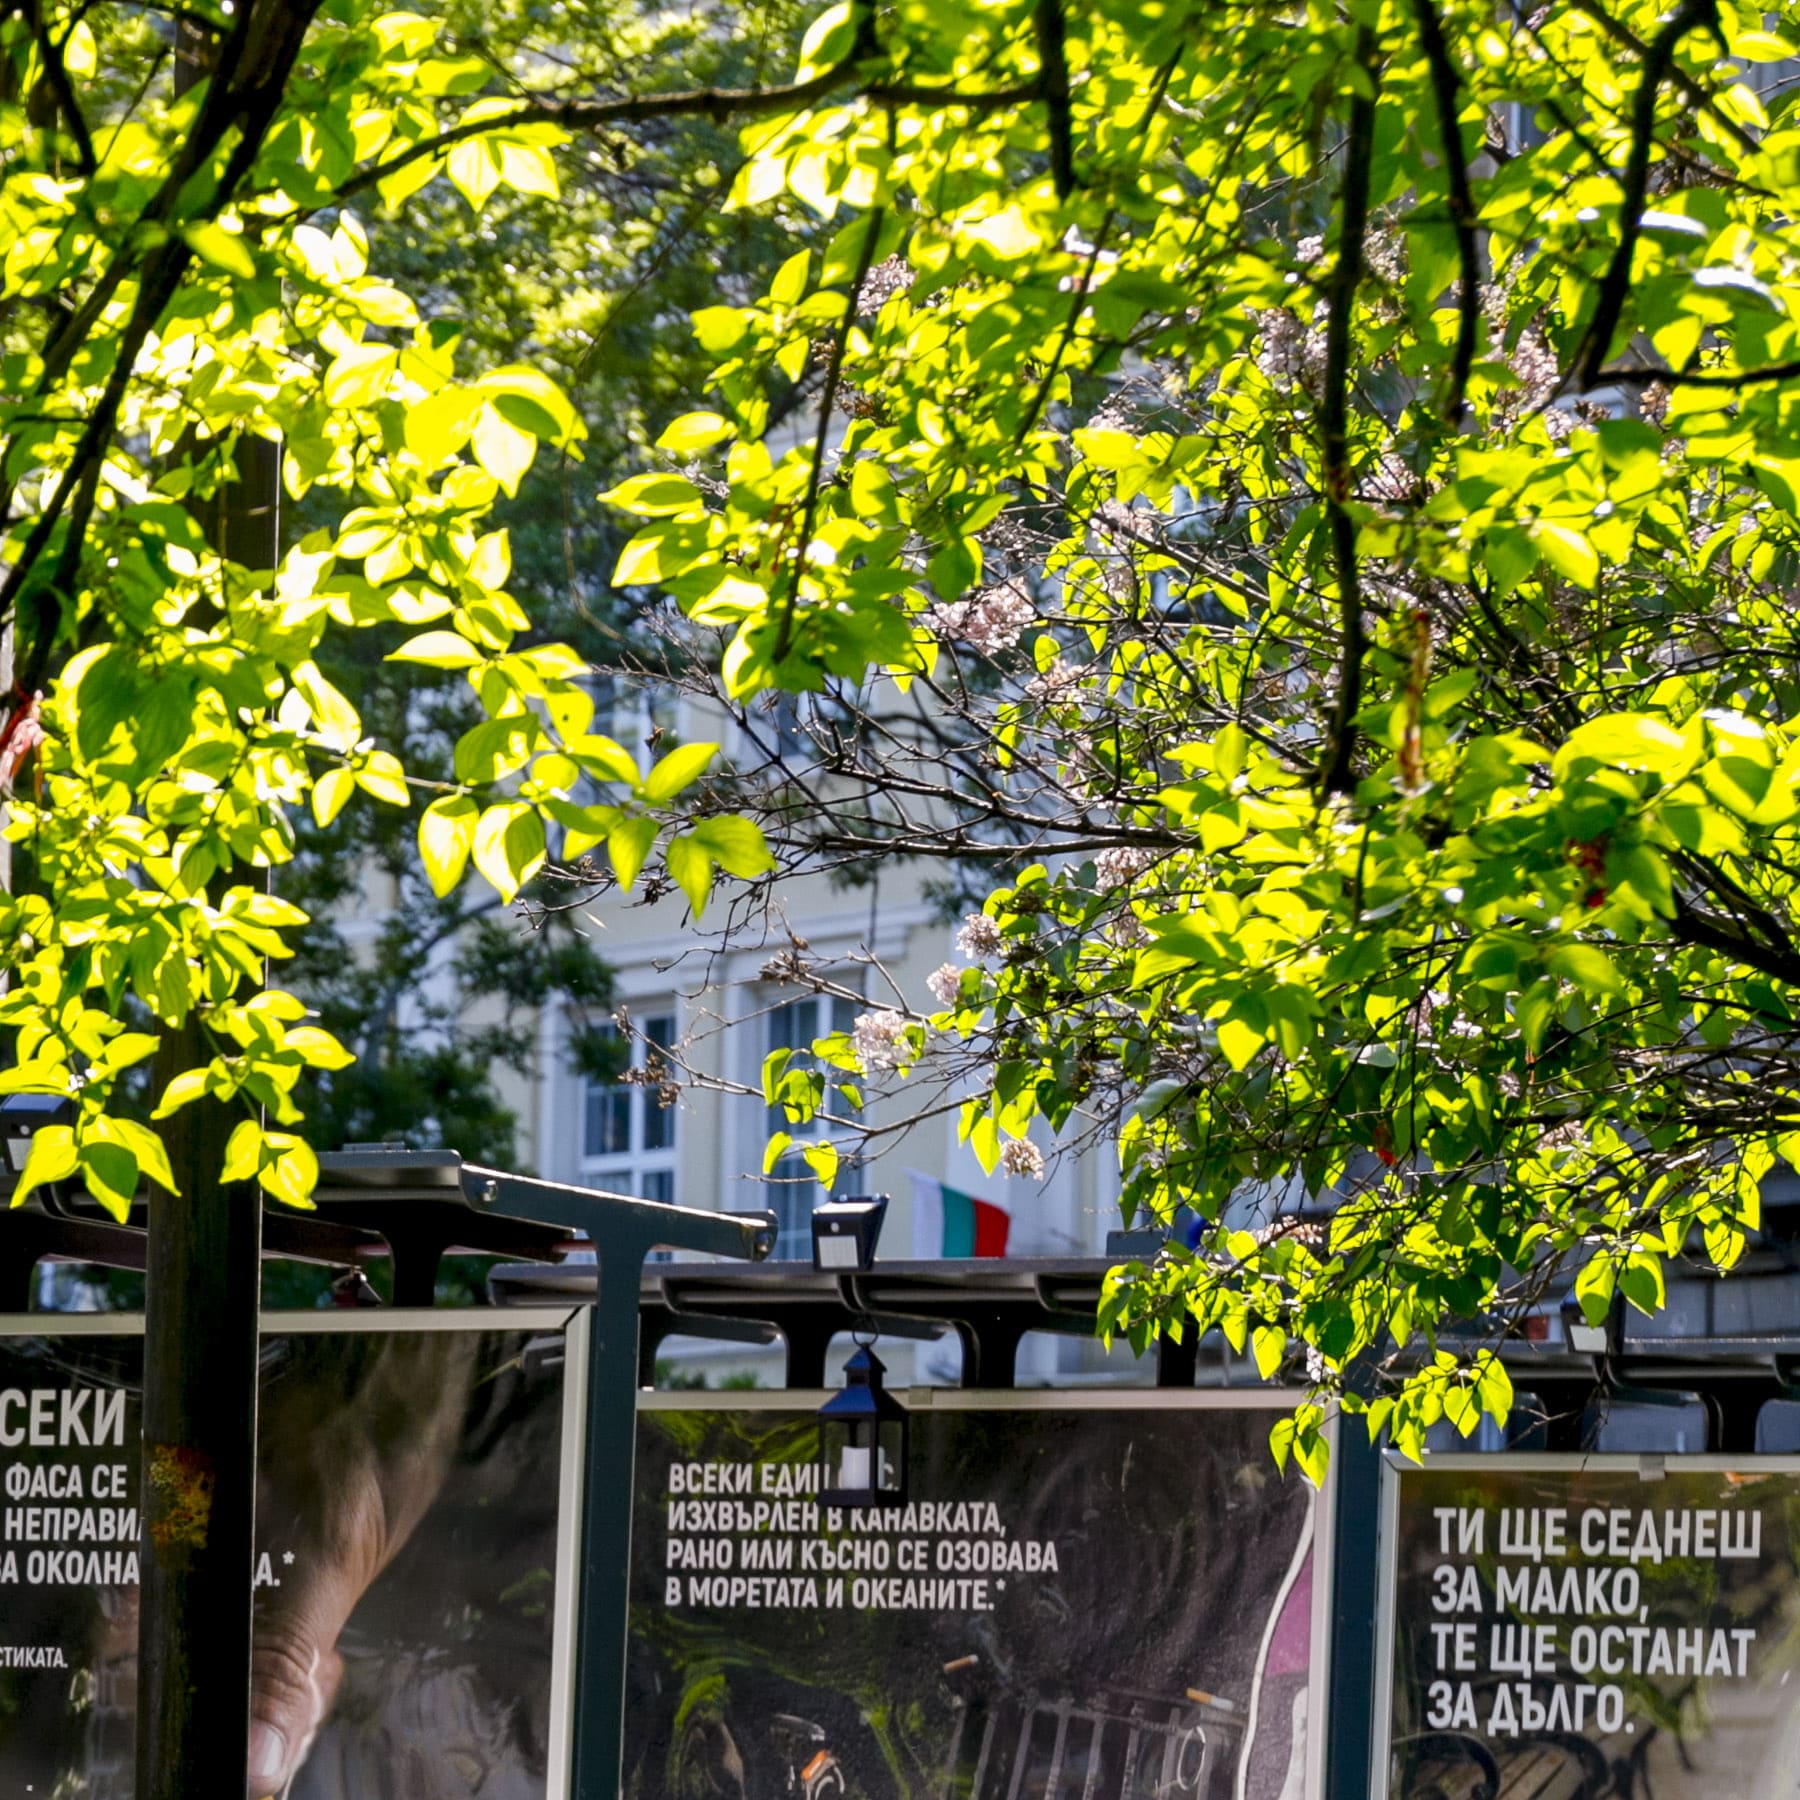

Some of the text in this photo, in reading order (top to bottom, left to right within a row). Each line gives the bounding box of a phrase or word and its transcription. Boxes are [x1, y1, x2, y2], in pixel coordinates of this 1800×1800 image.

[5, 1462, 84, 1500] ФАСА
[91, 1464, 128, 1499] СЕ
[669, 1463, 752, 1493] ВСЕКИ
[667, 1501, 819, 1532] ИЗХВЪРЛЕН
[851, 1502, 1006, 1538] КАНАВКАТА,
[1434, 1507, 1761, 1564] ТИ ЩЕ СЕДНЕШ
[666, 1538, 1059, 1572] РАНО ИЛИ КЪСНО СЕ ОЗОВАВА
[665, 1576, 682, 1606] В
[688, 1576, 818, 1608] МОРЕТАТА
[825, 1578, 843, 1608] И
[1431, 1564, 1649, 1623] ЗА МАЛКО,
[1430, 1623, 1756, 1679] ТЕ ЩЕ ОСТАНАТ
[1427, 1680, 1635, 1737] ЗА ДЪЛГО.
